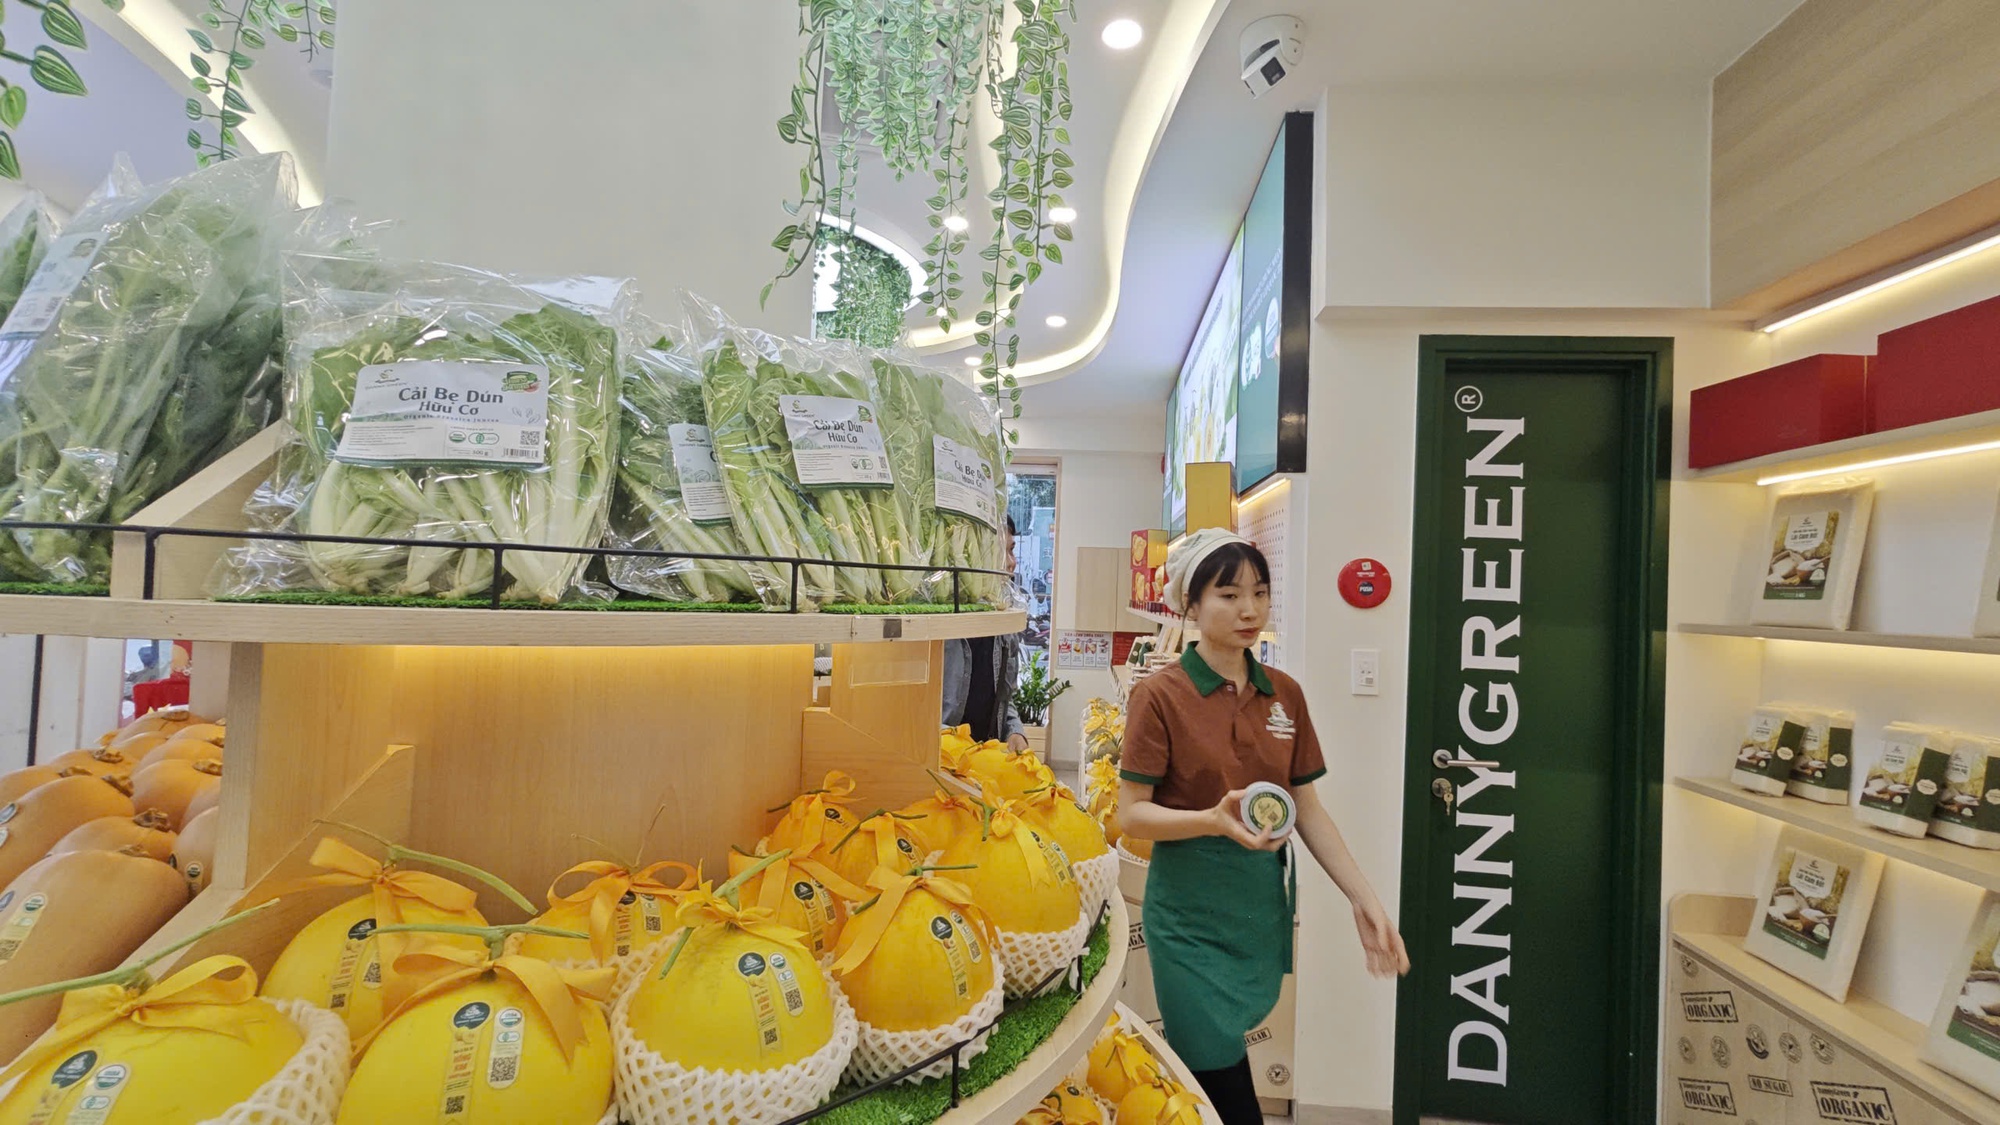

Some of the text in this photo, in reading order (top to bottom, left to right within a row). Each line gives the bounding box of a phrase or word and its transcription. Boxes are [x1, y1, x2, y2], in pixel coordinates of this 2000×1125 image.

[398, 386, 503, 405] Cải Bẹ Dún
[419, 401, 479, 415] Hữu Cơ
[847, 420, 864, 433] Dún
[1447, 416, 1526, 1087] DANNYGREEN
[1687, 1004, 1733, 1018] ORGANIC
[1685, 1090, 1732, 1110] ORGANIC
[1820, 1097, 1890, 1121] ORGANIC
